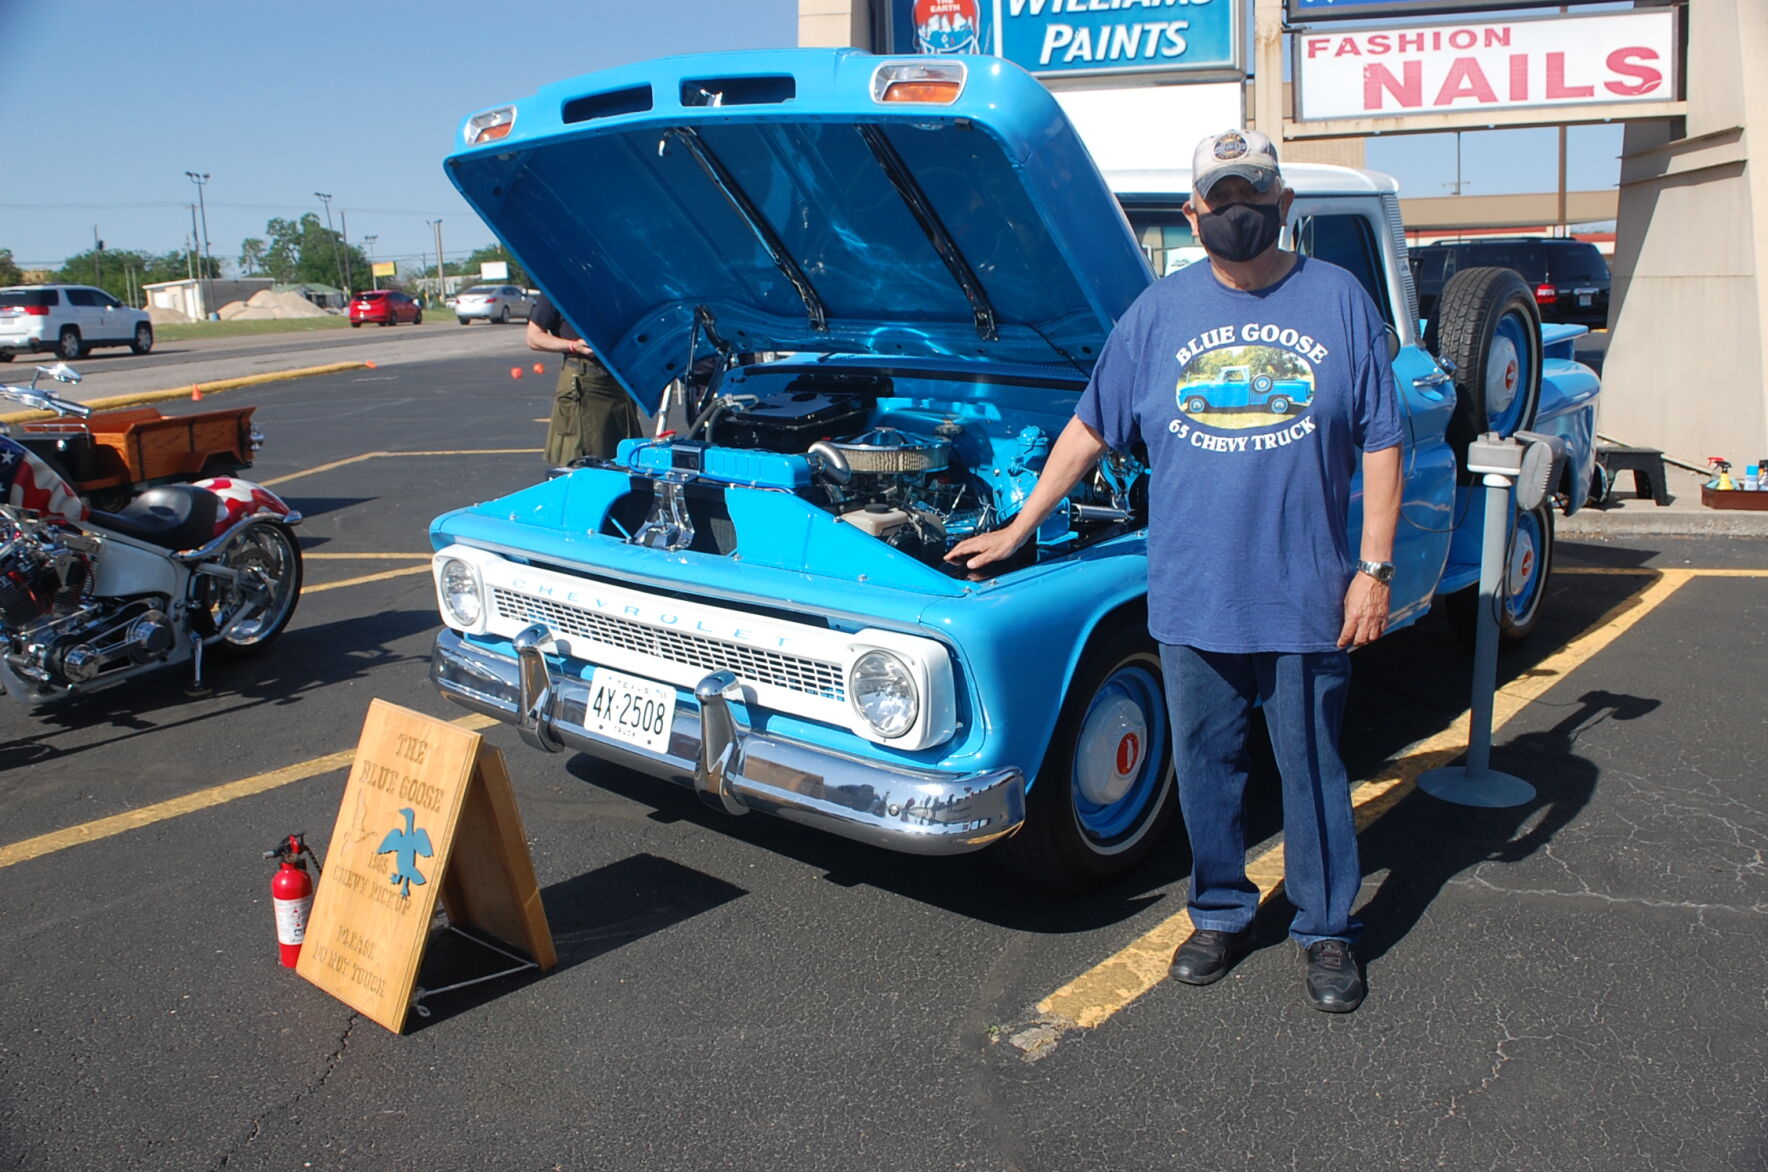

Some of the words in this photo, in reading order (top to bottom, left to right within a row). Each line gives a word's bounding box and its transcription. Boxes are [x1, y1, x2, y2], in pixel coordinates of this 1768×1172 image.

[1039, 20, 1190, 65] PAINTS
[1307, 27, 1511, 59] FASHION
[1363, 46, 1663, 111] NAILS
[1175, 325, 1236, 367] BLUE
[1241, 323, 1329, 364] GOOSE
[1168, 419, 1191, 439] 65
[1190, 431, 1249, 452] CHEVY
[1250, 415, 1316, 451] TRUCK
[512, 578, 793, 647] CHEVROLET
[395, 733, 428, 765] THE
[359, 760, 400, 795] BLUE
[399, 776, 445, 813] GOOSE
[333, 865, 369, 895] CHEVY
[336, 925, 376, 960] PLEASE
[327, 950, 350, 975] NOT
[351, 963, 386, 998] TOUCH
